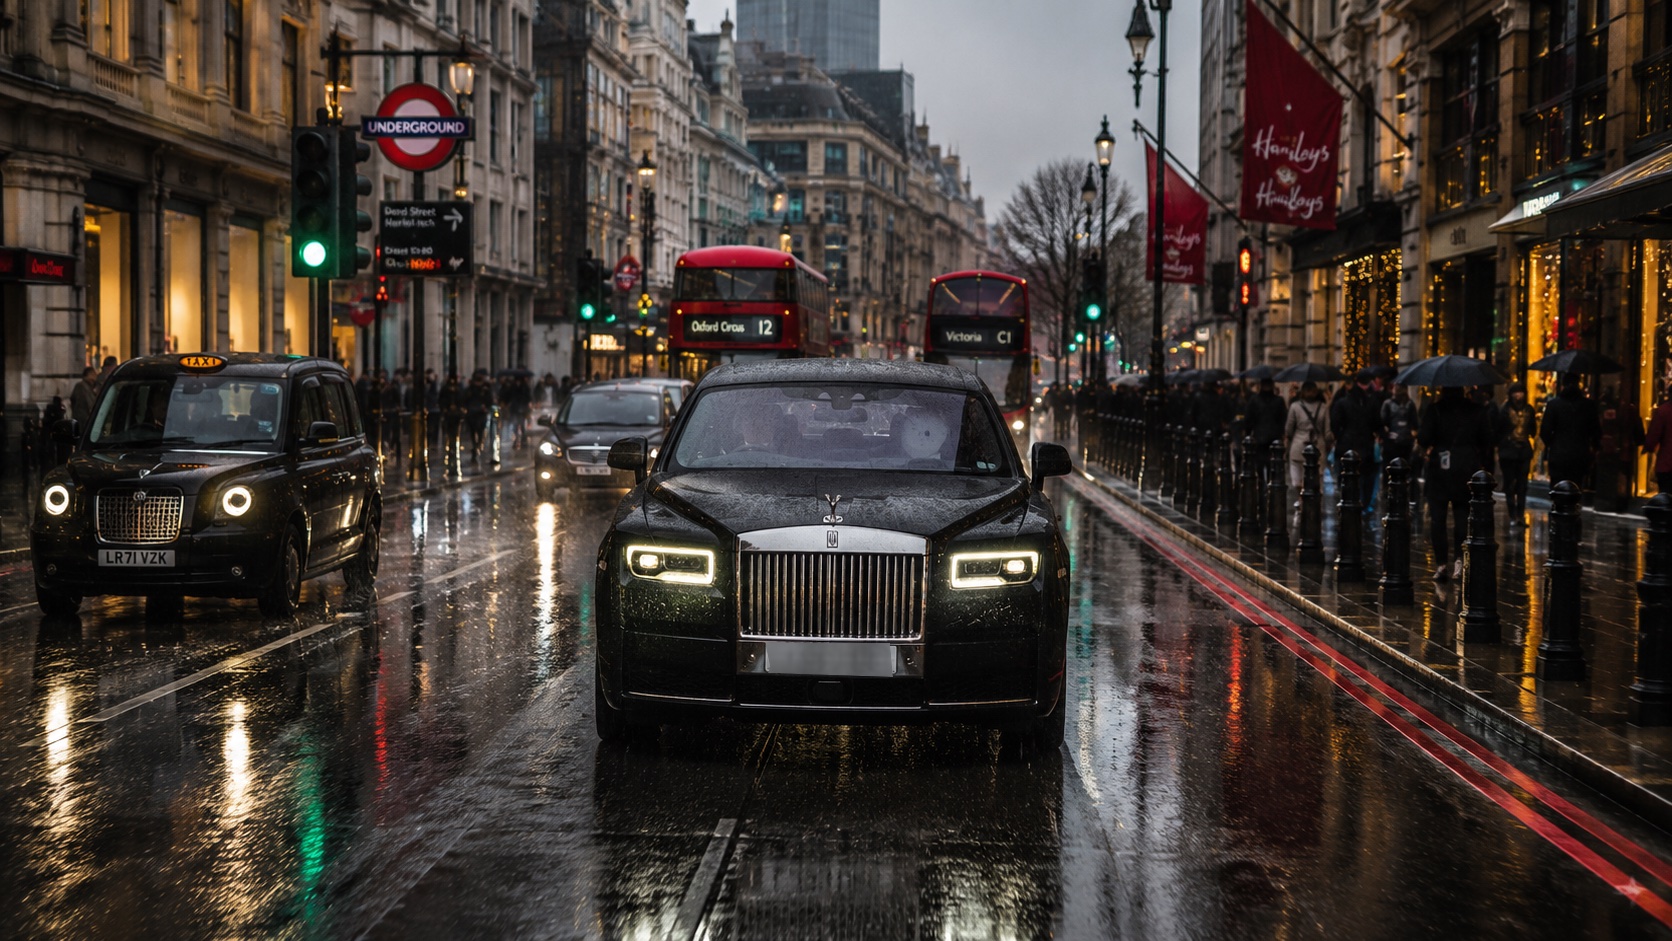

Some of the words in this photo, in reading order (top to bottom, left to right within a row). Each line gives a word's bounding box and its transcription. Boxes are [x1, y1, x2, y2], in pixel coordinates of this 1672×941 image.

[368, 121, 465, 134] UNDERGROUND
[691, 320, 719, 333] Oxford
[758, 319, 773, 336] 12
[946, 331, 982, 342] Victoria
[997, 330, 1012, 344] C1
[187, 357, 216, 366] TAXI
[106, 551, 137, 565] LR71
[140, 551, 167, 565] VZK
